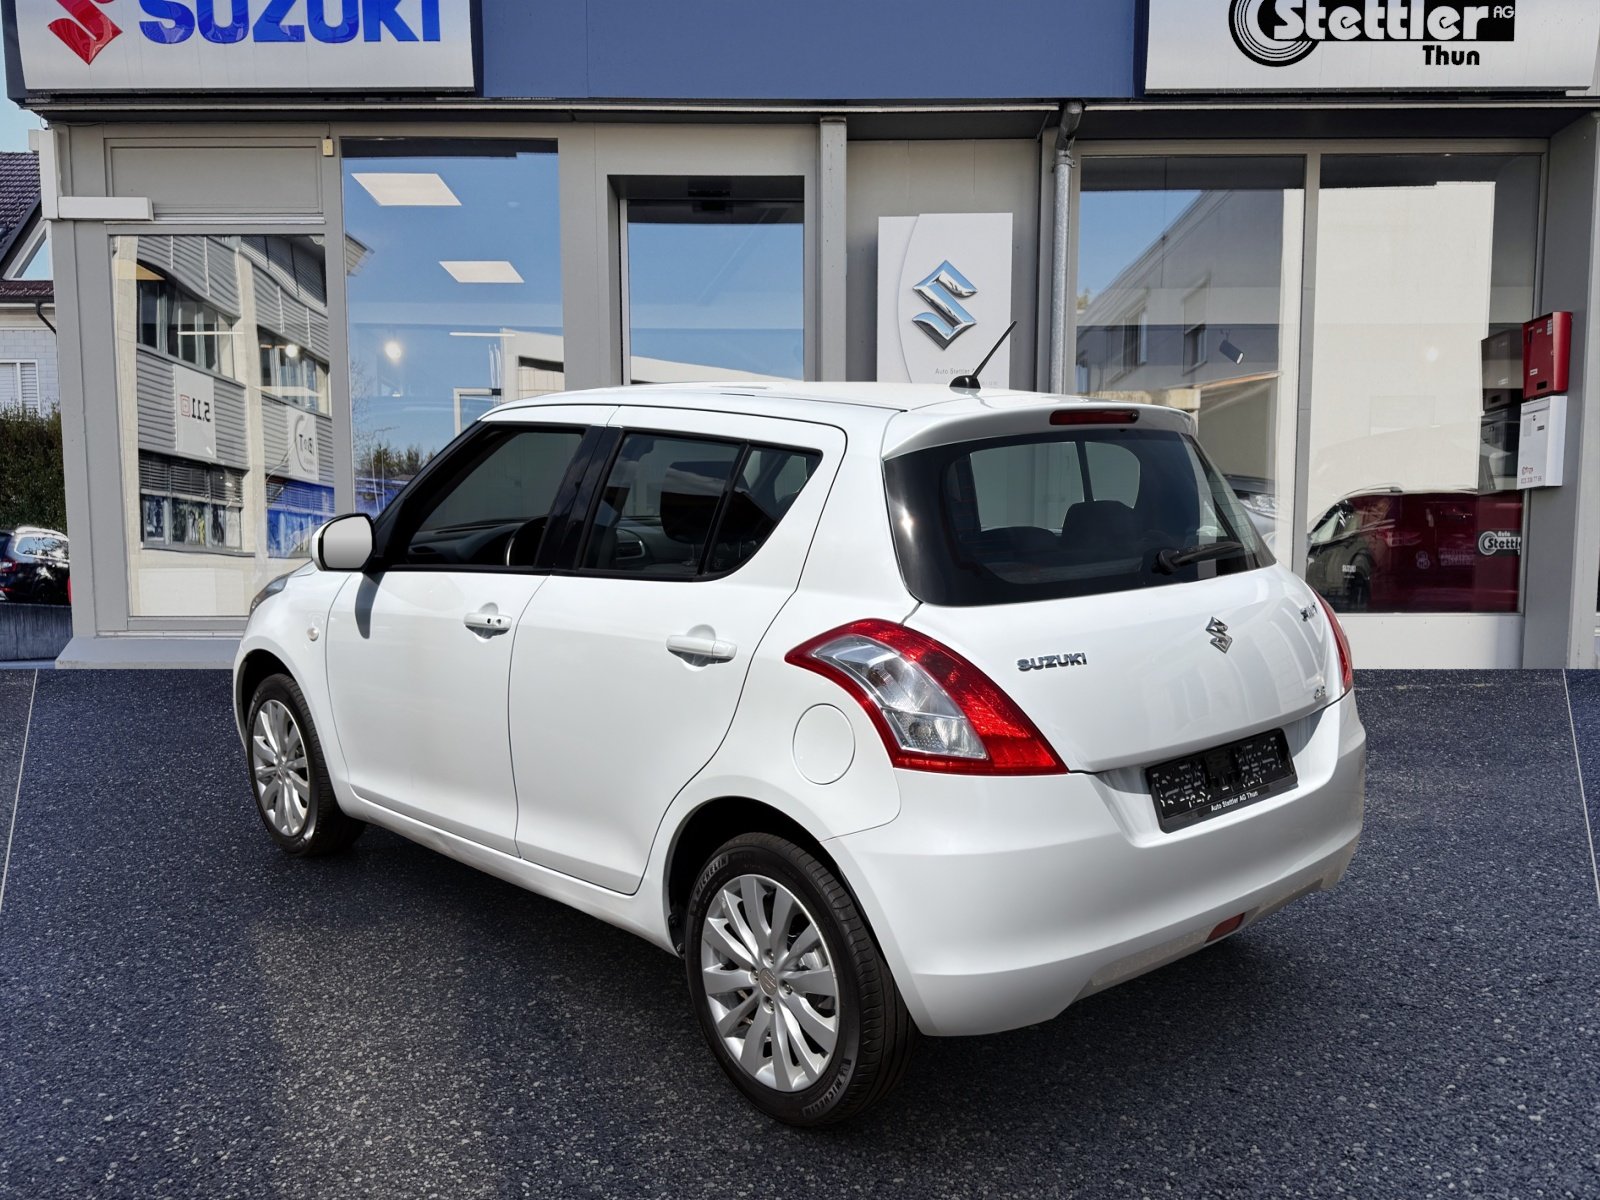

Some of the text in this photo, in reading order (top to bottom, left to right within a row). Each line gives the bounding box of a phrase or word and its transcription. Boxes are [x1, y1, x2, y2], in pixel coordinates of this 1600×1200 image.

[139, 0, 441, 44] SUZUKI
[1273, 0, 1515, 41] Stettler AG
[1422, 45, 1480, 66] Thun
[1017, 652, 1088, 672] SUZUKI
[1222, 797, 1239, 807] Stettler
[1239, 794, 1247, 802] AG
[1247, 791, 1258, 799] Thun
[804, 1077, 843, 1116] MICHELIN
